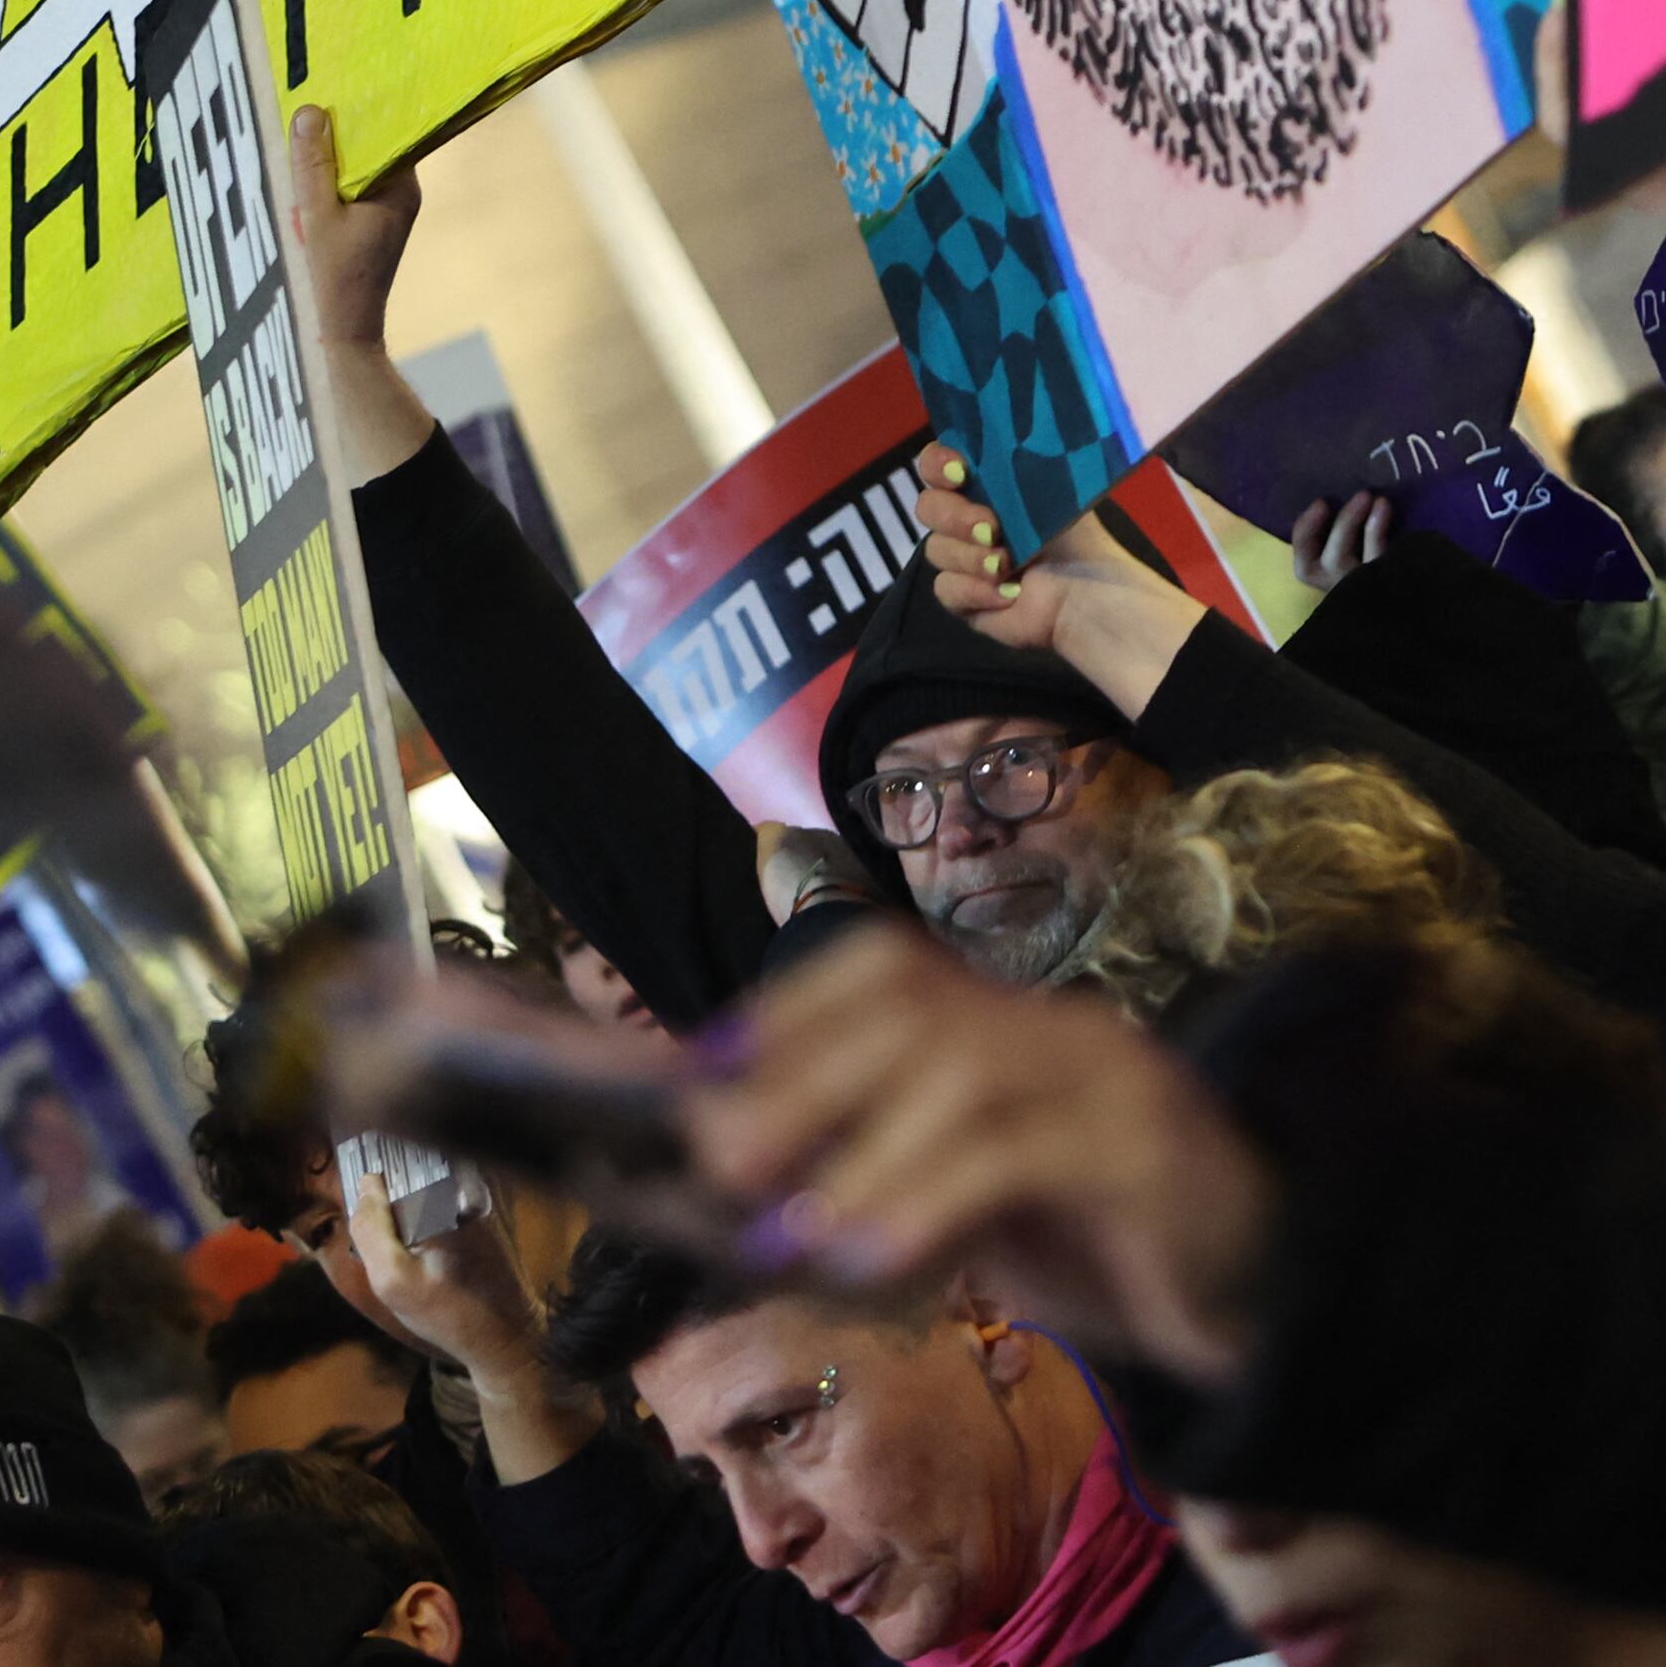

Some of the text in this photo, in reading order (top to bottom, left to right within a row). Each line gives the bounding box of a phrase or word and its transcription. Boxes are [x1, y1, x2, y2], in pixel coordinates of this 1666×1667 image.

[204, 285, 315, 552] IS BACK!
[1369, 420, 1502, 480] ביחד
[240, 518, 349, 735] TOO MANY
[270, 692, 390, 928] NOT YET!
